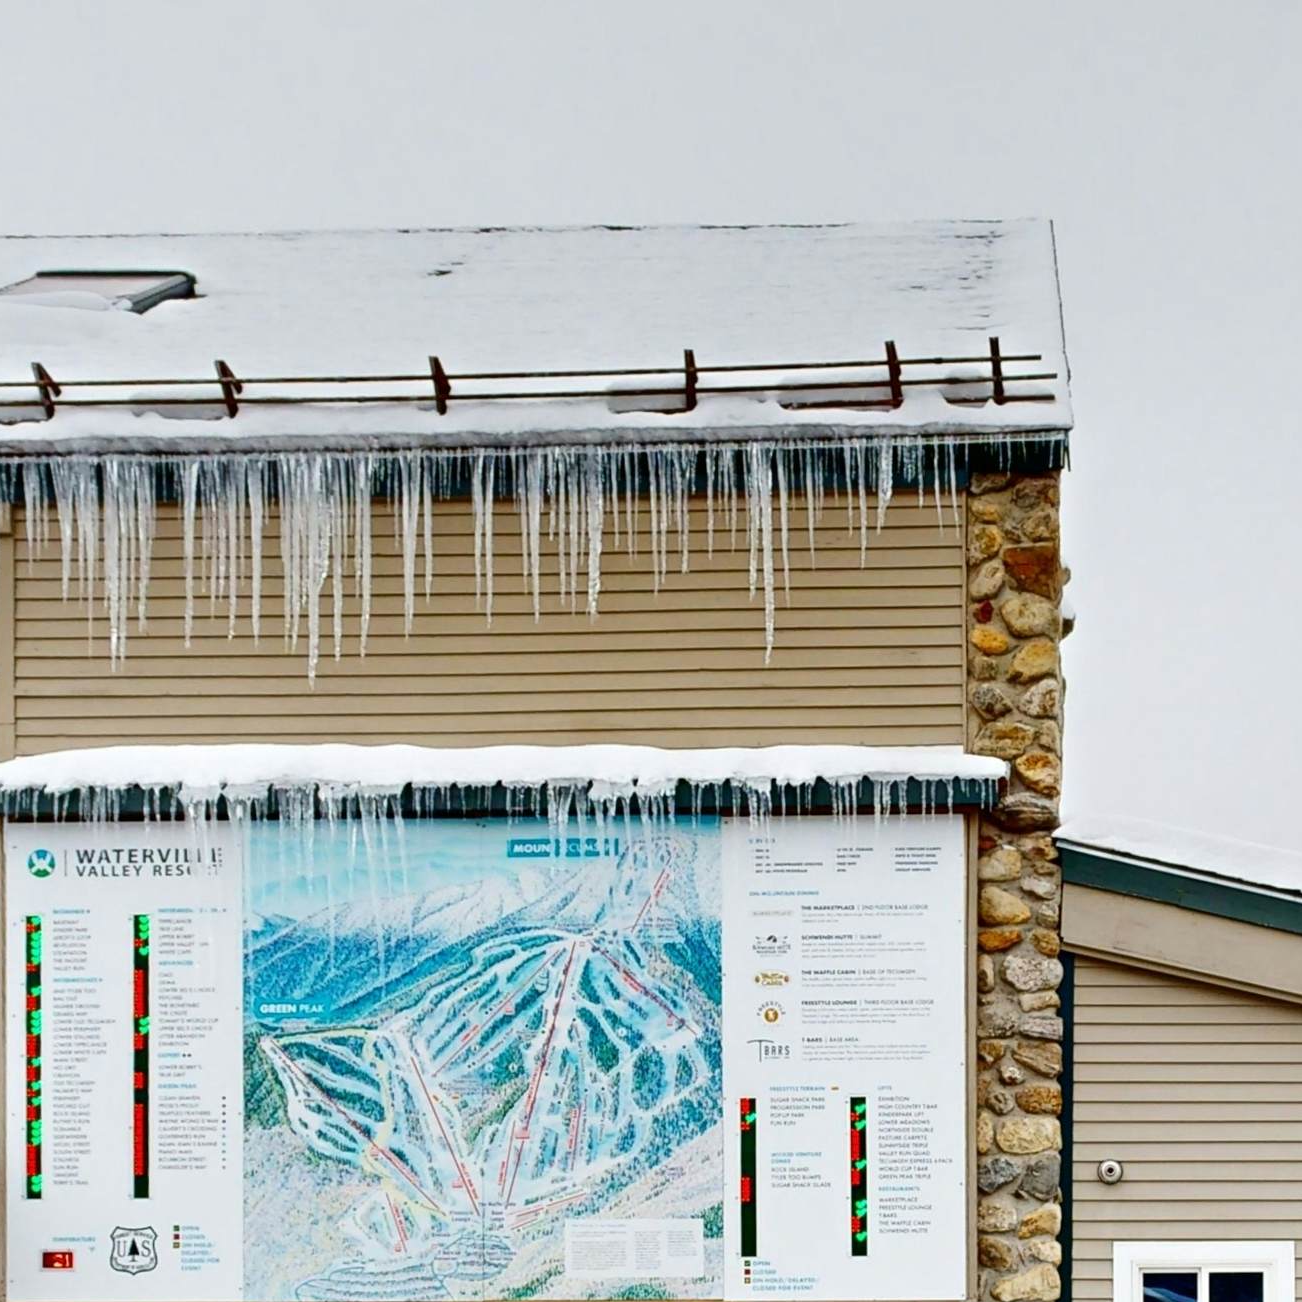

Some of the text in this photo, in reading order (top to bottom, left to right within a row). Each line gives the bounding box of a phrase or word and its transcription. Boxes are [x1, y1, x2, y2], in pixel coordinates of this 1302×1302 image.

[513, 843, 551, 853] MOUN
[76, 866, 142, 877] VALLEY
[260, 1004, 323, 1013] GREEN PEAK
[117, 1240, 152, 1258] U S
